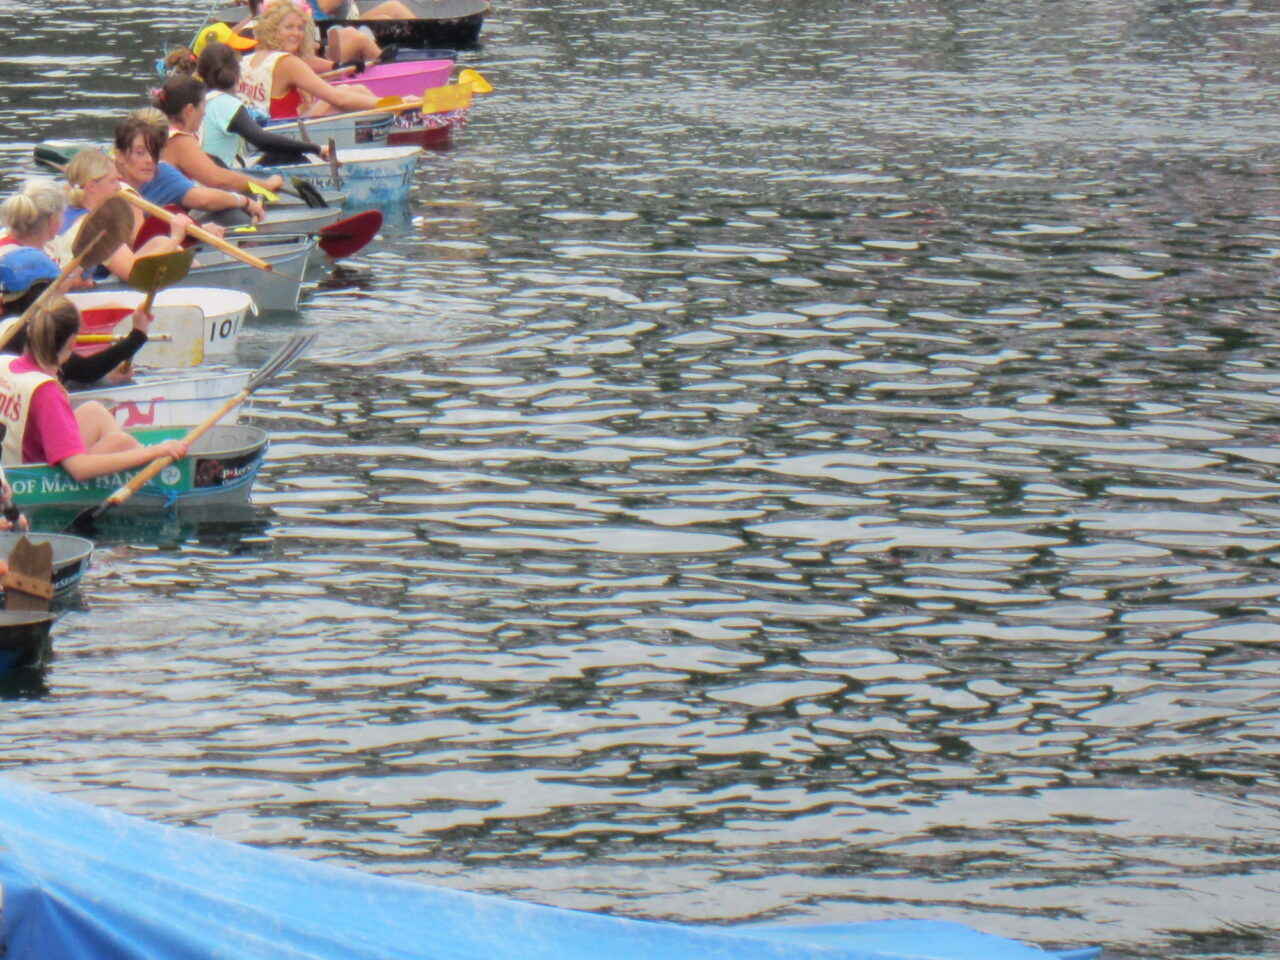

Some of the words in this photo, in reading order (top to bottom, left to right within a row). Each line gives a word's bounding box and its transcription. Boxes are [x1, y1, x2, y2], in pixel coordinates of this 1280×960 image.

[210, 315, 239, 341] 101
[12, 479, 36, 494] OF
[41, 473, 90, 493] MAN
